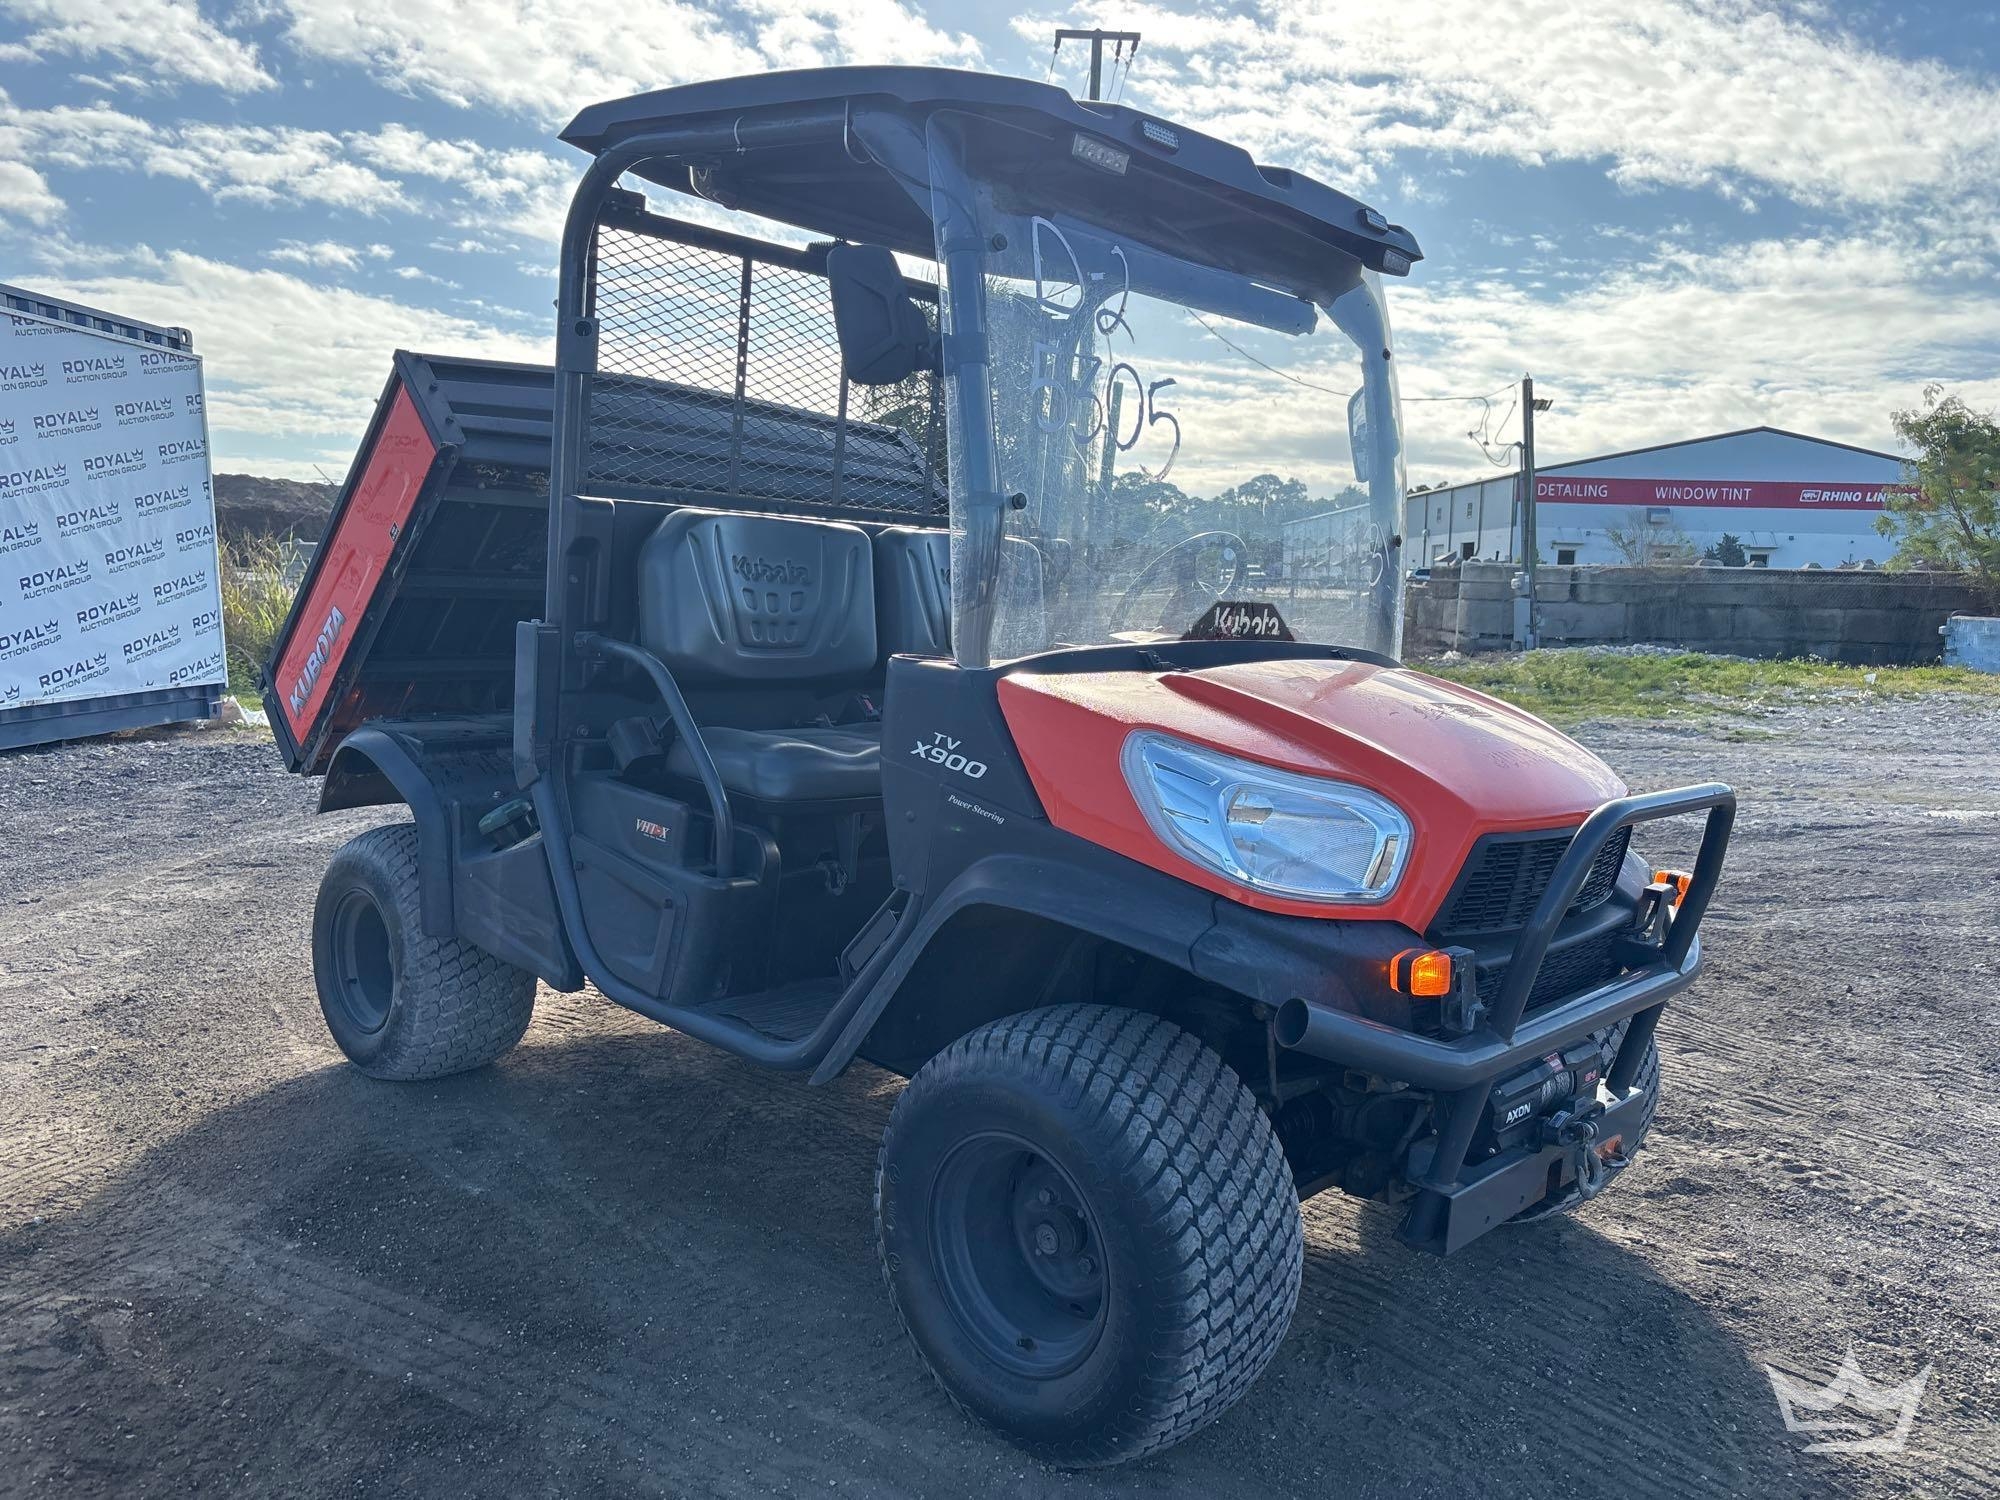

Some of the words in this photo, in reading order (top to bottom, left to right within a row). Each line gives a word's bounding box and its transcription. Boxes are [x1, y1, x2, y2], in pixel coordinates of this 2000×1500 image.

[15, 327, 52, 336] AUCTION
[62, 358, 113, 373] ROYAL
[140, 353, 184, 366] ROYAL
[143, 367, 173, 375] AUCTION
[173, 363, 197, 372] GROUP
[0, 366, 31, 380] YAL
[66, 374, 101, 384] AUCTION
[101, 371, 127, 380] GROUP
[19, 380, 47, 389] GROUP
[114, 400, 161, 416] ROYAL
[33, 411, 87, 429] ROYAL
[118, 415, 150, 426] AUCTION
[150, 411, 174, 420] GROUP
[0, 436, 18, 445] OUP
[38, 427, 74, 439] AUCTION
[75, 423, 102, 433] GROUP
[158, 440, 201, 456] ROYAL
[161, 454, 190, 464] AUCTION
[190, 451, 206, 459] GRO
[83, 452, 132, 471] ROYAL
[0, 467, 54, 488] ROYAL
[87, 468, 120, 480] AUCTION
[121, 463, 147, 473] GROUP
[2, 484, 40, 499] AUCTION
[41, 479, 70, 490] GROUP
[134, 489, 179, 508] ROYAL
[1537, 483, 1608, 498] DETAILING
[1655, 486, 1719, 501] WINDOW
[1722, 488, 1752, 501] TINT
[1821, 491, 1861, 502] RHINO
[56, 506, 107, 528] ROYAL
[138, 505, 168, 517] AUCTION
[169, 499, 191, 509] GROUP
[60, 524, 95, 538] AUCTION
[96, 517, 122, 528] GROUP
[11, 537, 41, 551] GROUP
[179, 539, 207, 552] AUCTION
[105, 543, 152, 565] ROYAL
[108, 560, 140, 574] AUCTION
[141, 552, 165, 564] GROUP
[19, 565, 76, 590] ROYAL
[23, 584, 62, 600] AUCTION
[63, 574, 91, 588] GROUP
[153, 575, 196, 597] ROYAL
[156, 589, 185, 606] AUCTION
[185, 583, 207, 595] GROUP
[76, 598, 127, 624] ROYAL
[80, 616, 114, 633] AUCTION
[115, 607, 141, 620] GROUP
[192, 610, 219, 628] ROY
[195, 622, 219, 637] AUCTIO
[1214, 607, 1280, 636] Kubota
[0, 626, 45, 650] OYAL
[0, 645, 29, 660] CTION
[30, 634, 62, 650] GROUP
[123, 630, 168, 656] ROYAL
[126, 647, 157, 664] AUCTION
[157, 637, 181, 651] GROUP
[169, 658, 211, 683] ROYAL
[289, 605, 346, 717] KUBOTA
[39, 659, 94, 688] ROYAL
[42, 678, 80, 697] AUCTION
[81, 666, 110, 682] GROUP
[934, 731, 962, 750] TV
[910, 740, 988, 778] X900
[948, 794, 972, 810] Power
[972, 804, 1005, 824] Steering
[1505, 1102, 1530, 1124] AXON
